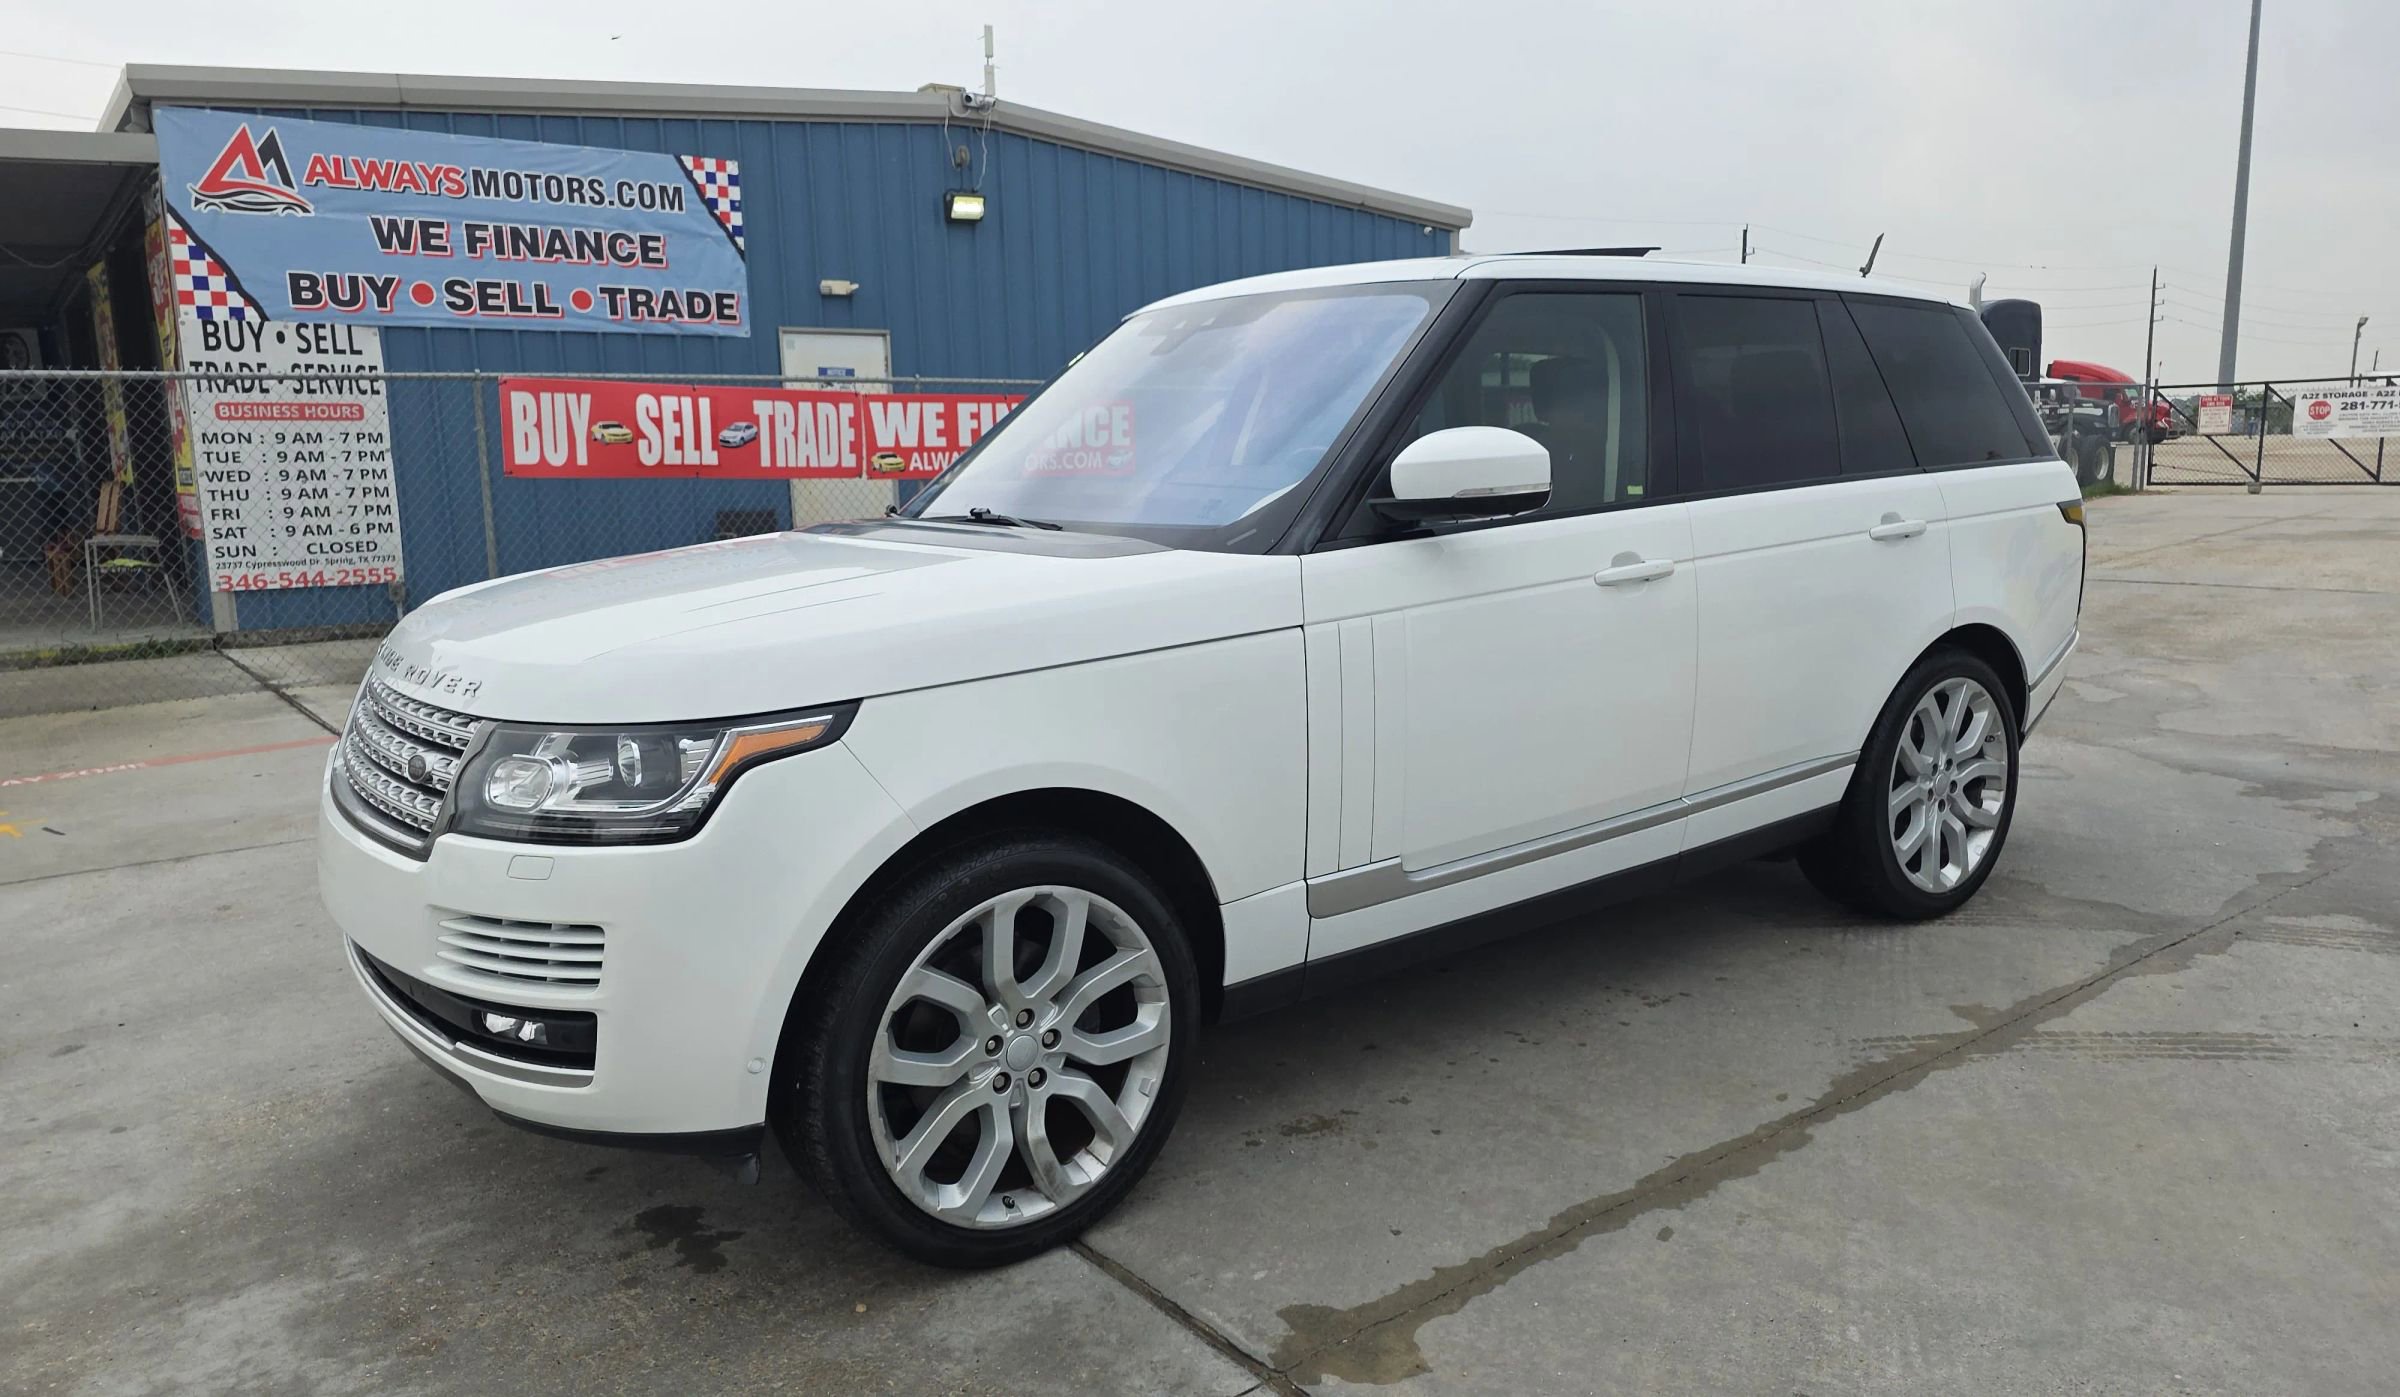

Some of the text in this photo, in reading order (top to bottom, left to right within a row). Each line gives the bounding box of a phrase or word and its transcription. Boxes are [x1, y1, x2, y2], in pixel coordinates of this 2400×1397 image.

[369, 215, 667, 267] WE FINANCE
[287, 271, 739, 323] BUY SELL TRADE
[201, 320, 363, 355] BUY SELL
[189, 361, 380, 395] TRADE SERVICE
[2323, 391, 2368, 399] STORAGE
[218, 405, 360, 418] BUSINESS HOURS
[2310, 406, 2331, 415] STOP
[2340, 400, 2400, 410] 281-771-
[511, 391, 856, 467] BUY SELL TRADE
[869, 402, 1132, 449] WE FINCE
[201, 433, 252, 444] MON
[275, 432, 286, 444] 9
[292, 432, 323, 444] AM
[339, 432, 350, 444] 7
[356, 432, 384, 444] PM
[203, 451, 242, 463] TUE
[277, 451, 288, 463] 9
[294, 451, 325, 463] AM
[341, 451, 351, 462] 7
[358, 450, 385, 462] PM
[205, 470, 251, 482] WED
[279, 470, 290, 482] 9
[296, 469, 326, 481] AM
[343, 469, 353, 481] 7
[360, 469, 387, 480] PM
[207, 489, 250, 501] THU
[281, 488, 292, 500] 9
[298, 488, 328, 499] AM
[345, 487, 356, 499] 7
[362, 486, 390, 498] PM
[211, 508, 241, 520] FRI
[283, 506, 294, 519] 9
[300, 506, 331, 518] AM
[348, 505, 358, 517] 7
[365, 505, 391, 517] PM
[212, 527, 247, 539] SAT
[285, 525, 296, 537] 9
[302, 524, 333, 536] AM
[350, 523, 360, 535] 6
[367, 523, 394, 534] PM
[215, 545, 256, 558] SUN
[307, 541, 377, 555] CLOSED
[216, 561, 242, 570] 23737
[246, 559, 307, 570] Cypresswood
[358, 556, 369, 564] TX
[371, 554, 396, 563] 77373
[217, 567, 396, 592] 346-544-2555
[405, 664, 482, 697] ROVER
